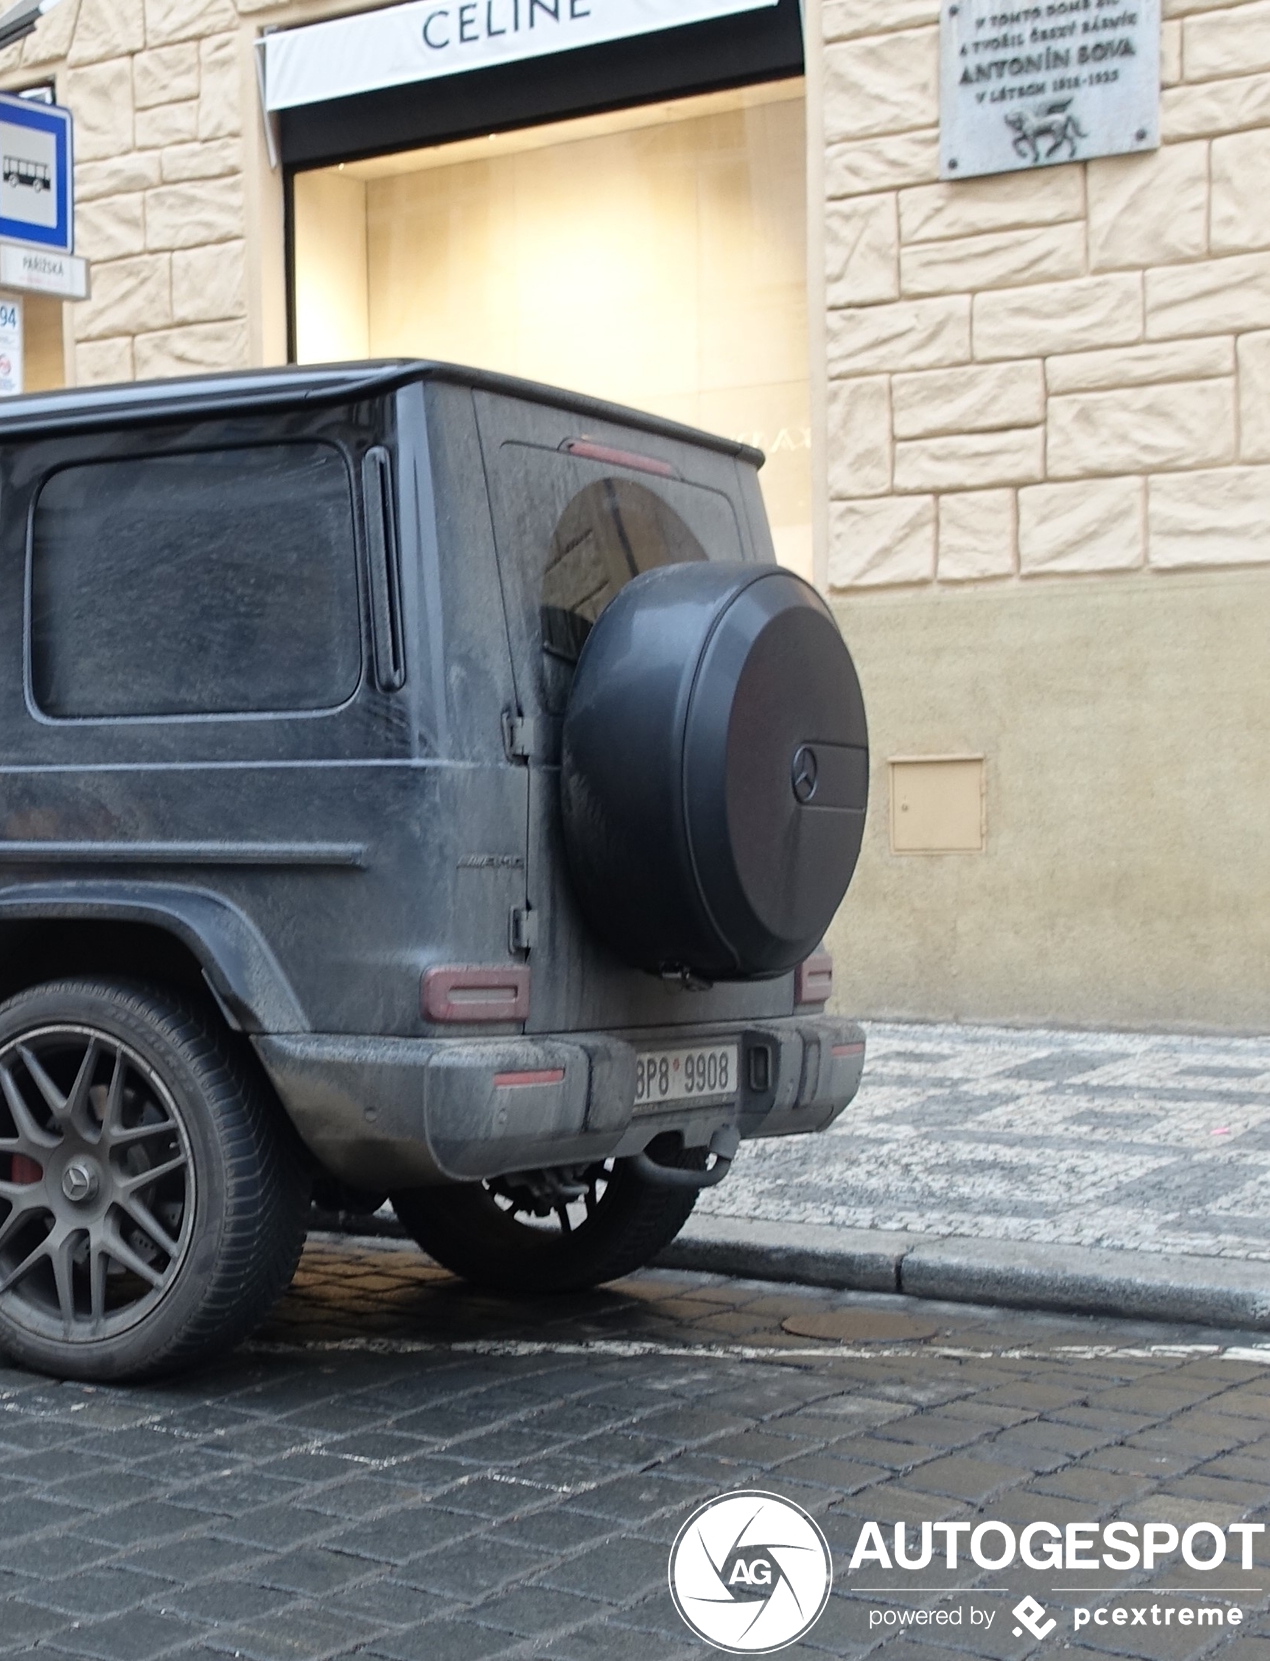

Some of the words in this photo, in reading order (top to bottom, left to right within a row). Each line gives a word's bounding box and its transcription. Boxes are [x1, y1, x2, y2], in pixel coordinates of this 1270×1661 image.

[422, 0, 591, 49] CELINE
[959, 46, 1070, 85] ANTONÍN
[684, 1051, 729, 1094] 9908
